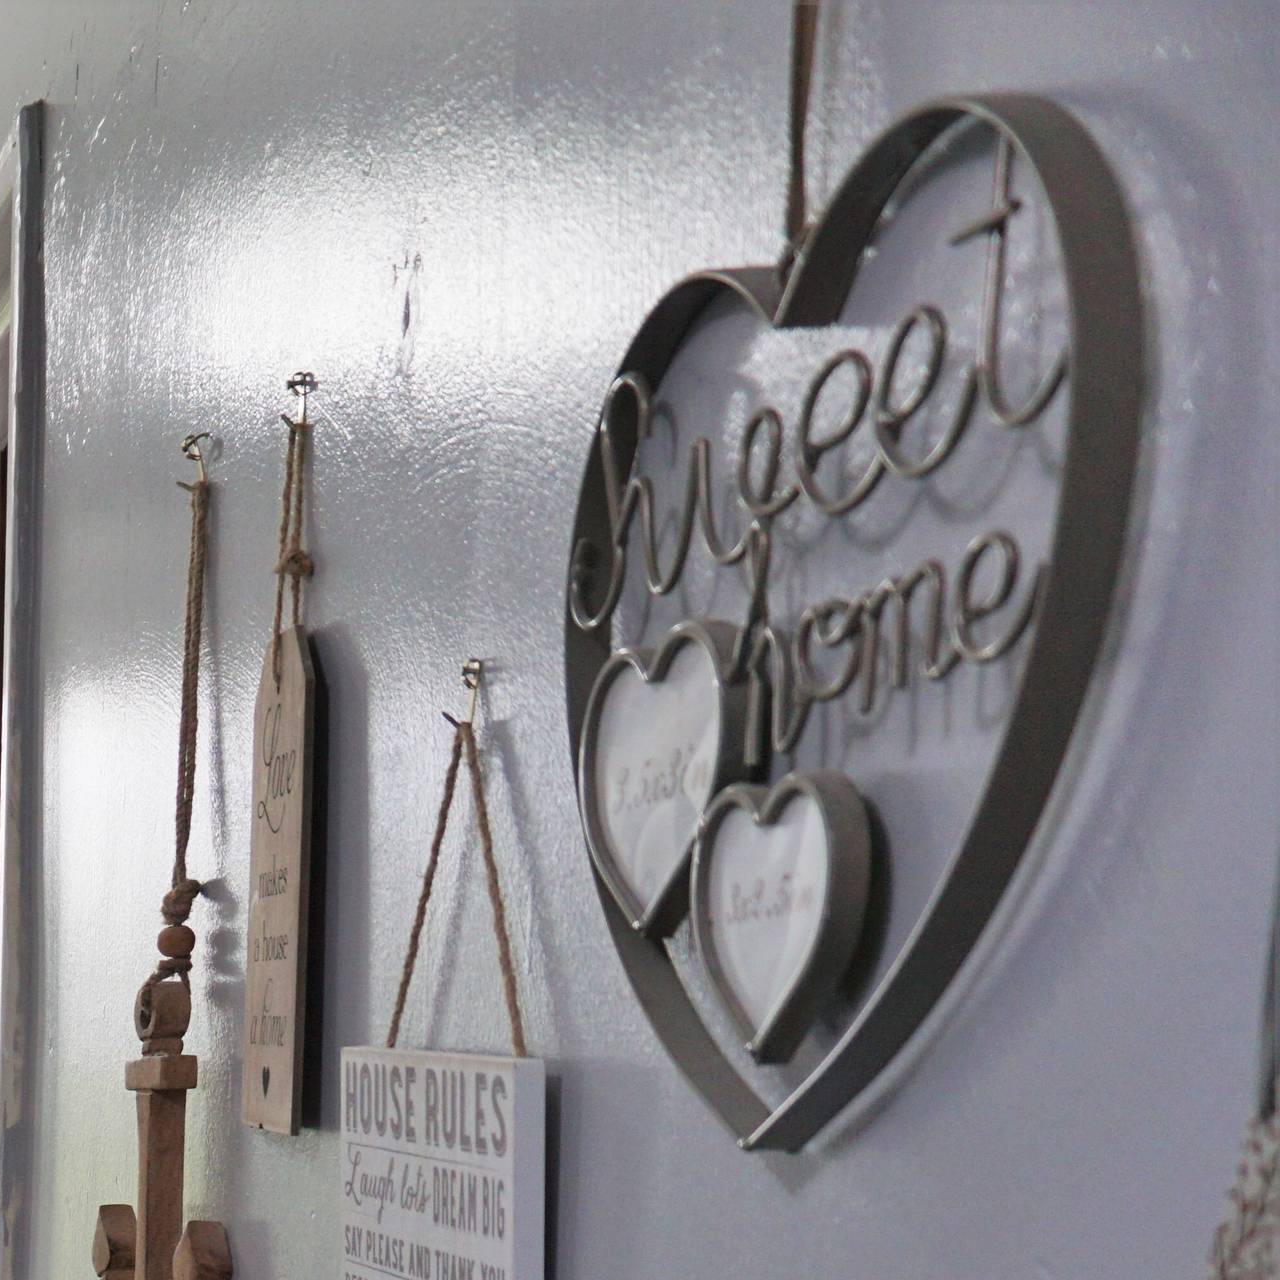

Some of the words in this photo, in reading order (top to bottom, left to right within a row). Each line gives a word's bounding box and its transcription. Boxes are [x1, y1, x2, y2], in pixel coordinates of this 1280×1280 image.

[724, 518, 1048, 768] home
[257, 702, 297, 835] Love
[258, 853, 289, 900] makes
[253, 937, 261, 963] a
[263, 919, 289, 962] house
[249, 1014, 258, 1046] a
[260, 977, 288, 1047] home
[345, 1060, 417, 1143] HOUSE
[425, 1067, 508, 1158] RULES
[345, 1143, 395, 1225] Laugh
[400, 1161, 431, 1214] lots
[433, 1165, 477, 1230] DREAM
[482, 1171, 506, 1240] BIG
[345, 1224, 363, 1257] SAY
[366, 1229, 405, 1274] PLEASE
